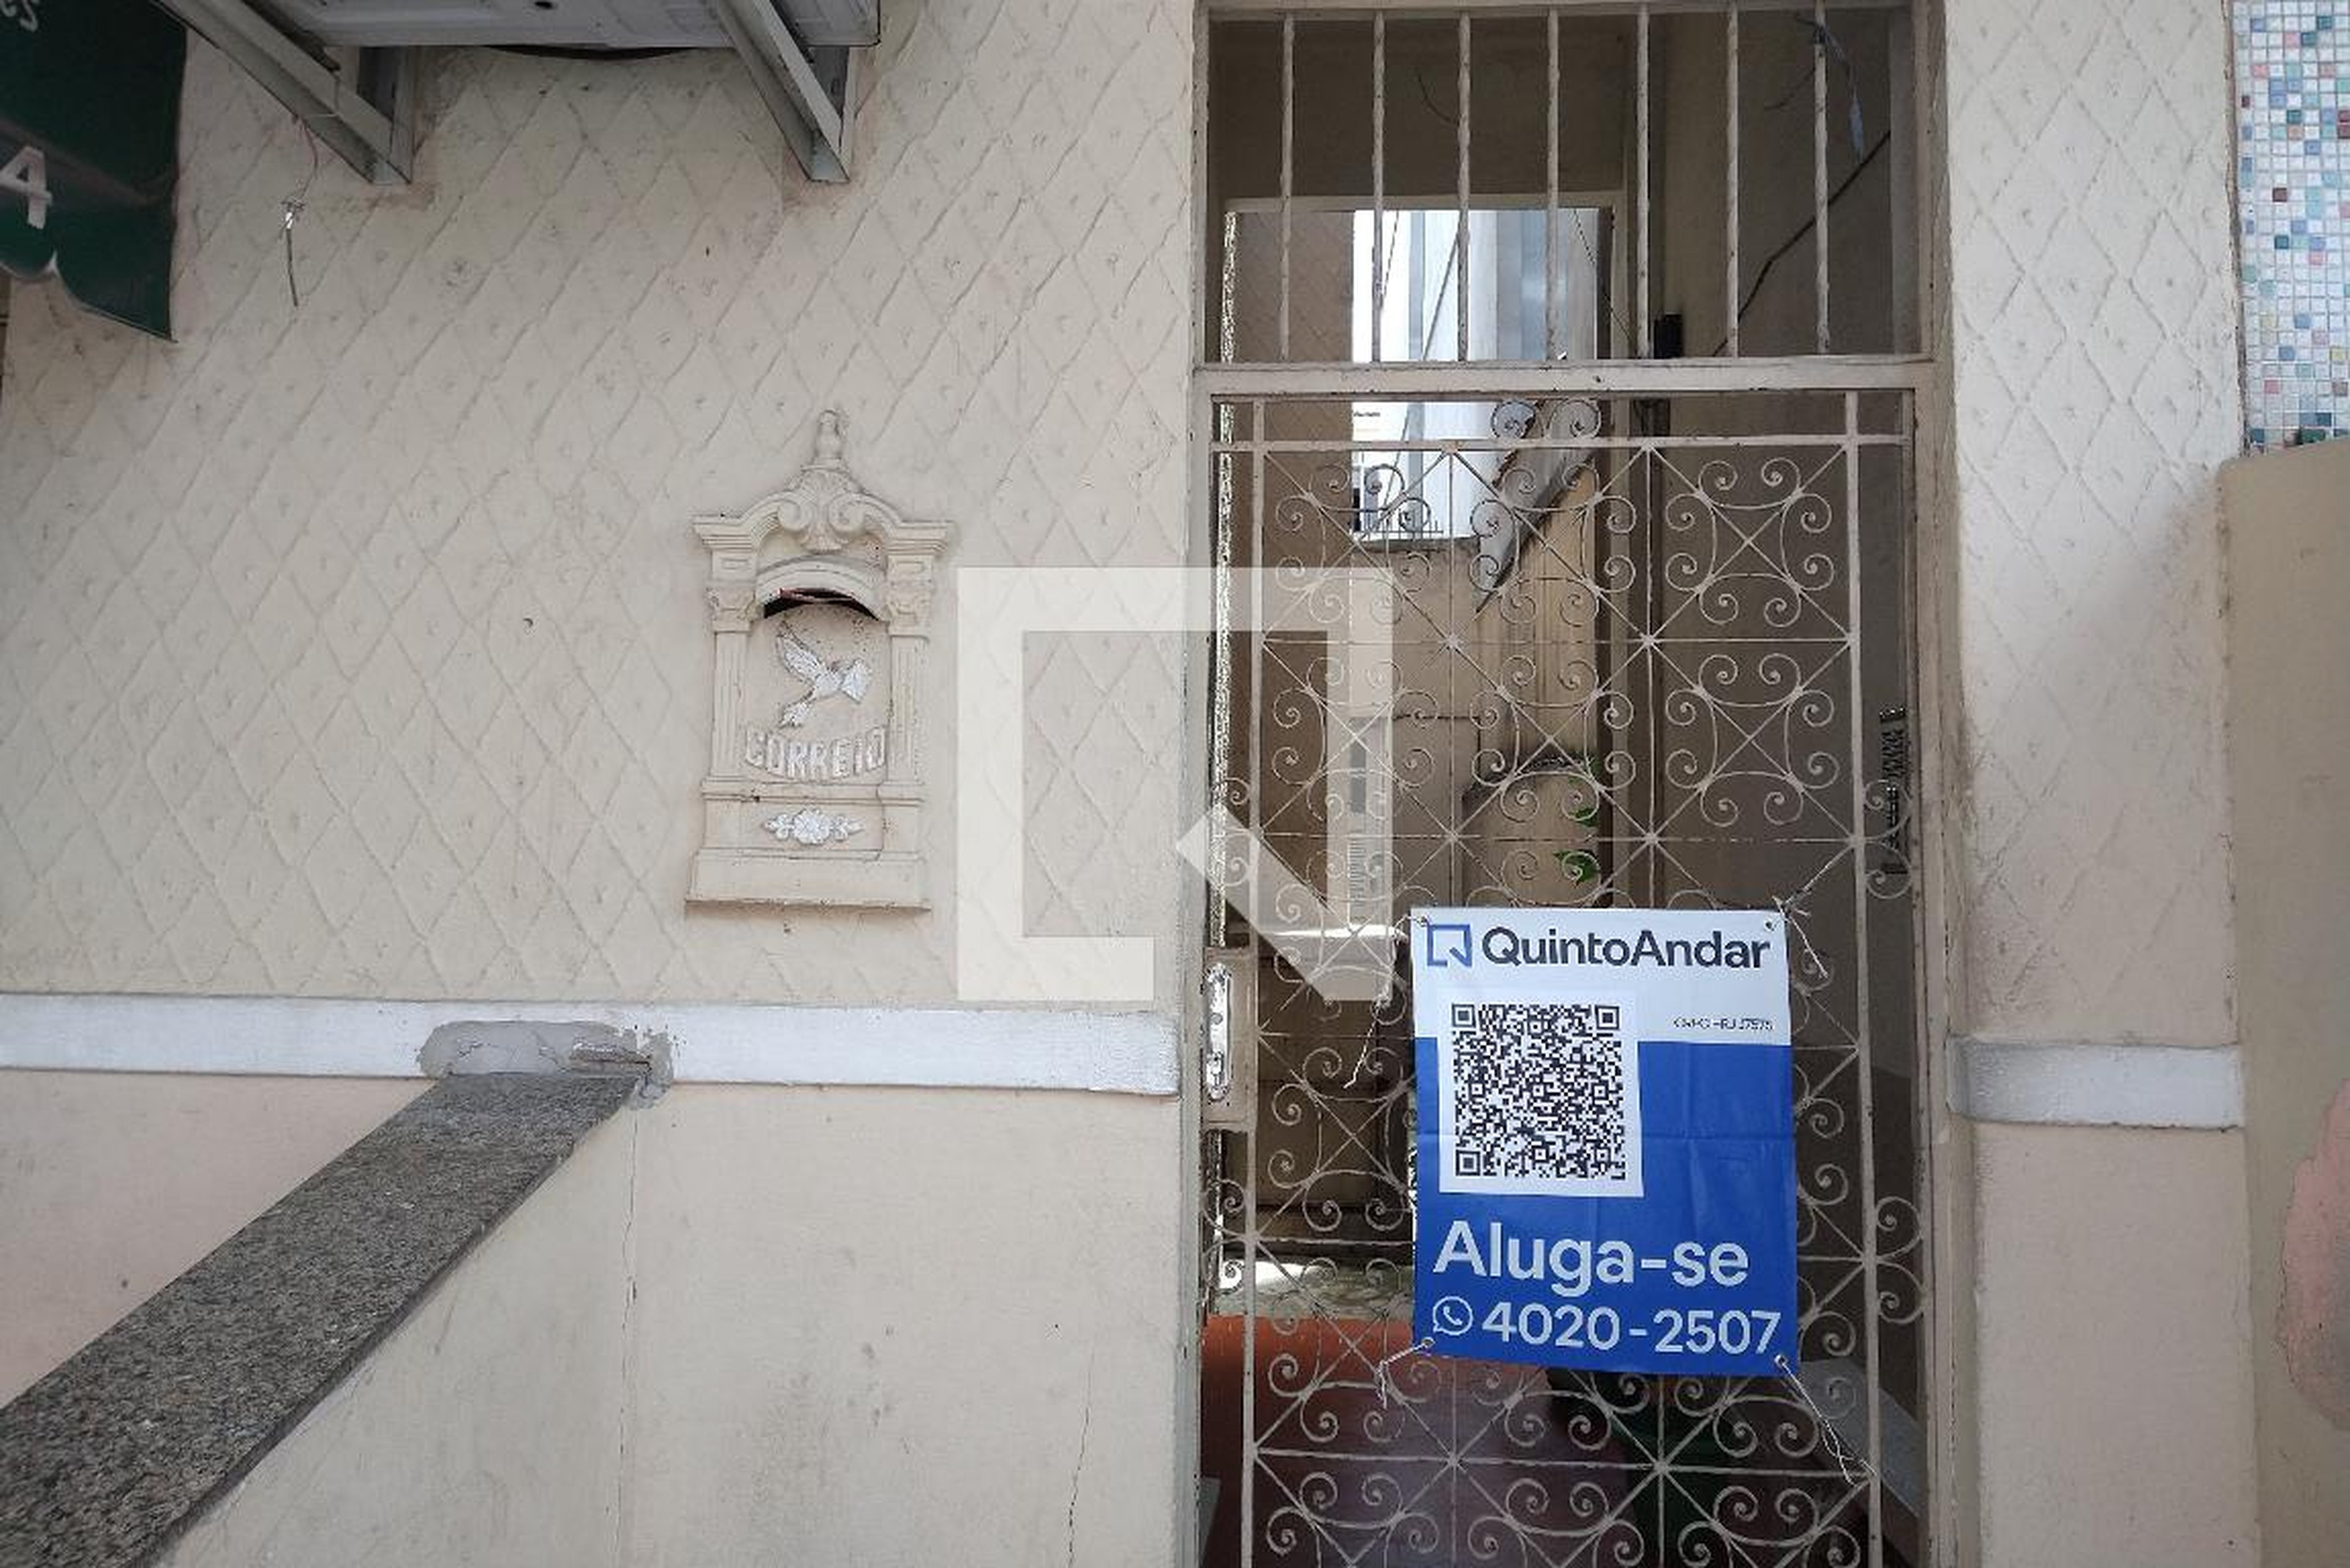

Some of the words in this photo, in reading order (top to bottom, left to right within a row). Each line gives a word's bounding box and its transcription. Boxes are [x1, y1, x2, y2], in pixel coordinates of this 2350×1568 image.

[745, 725, 887, 781] CORREIO
[1482, 926, 1771, 968] QuintoAndar
[1433, 1220, 1749, 1297] Aluga-se
